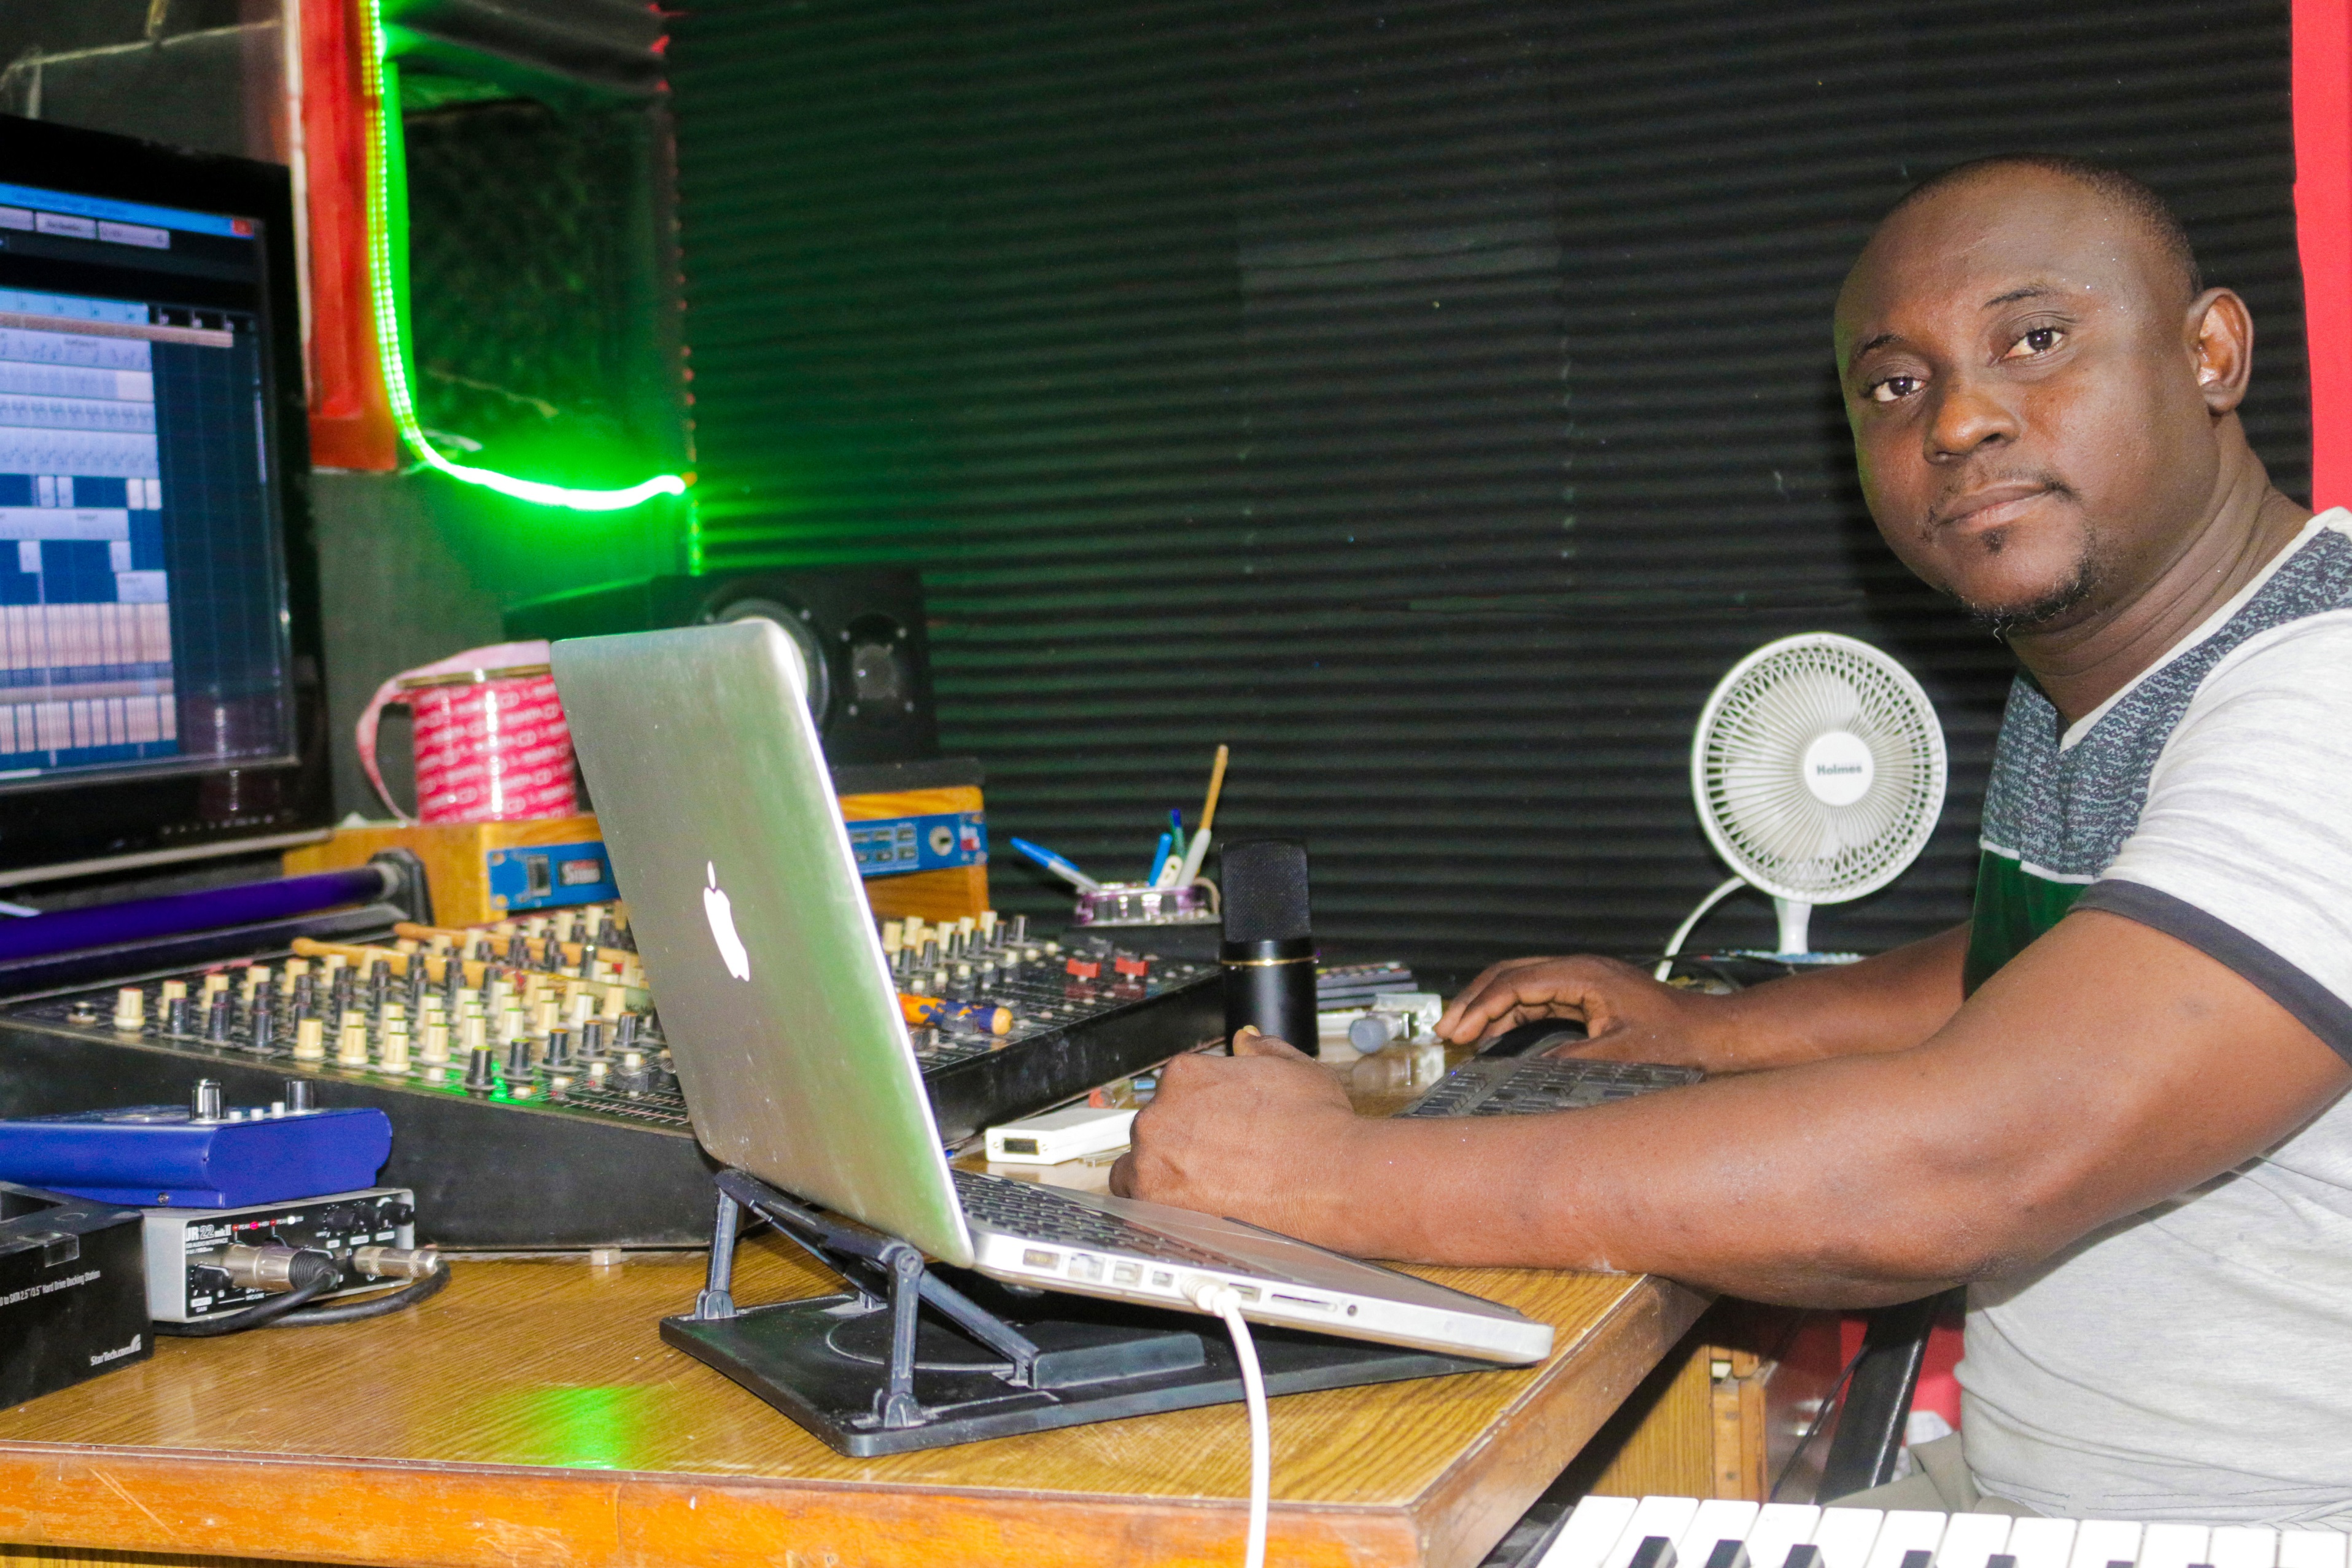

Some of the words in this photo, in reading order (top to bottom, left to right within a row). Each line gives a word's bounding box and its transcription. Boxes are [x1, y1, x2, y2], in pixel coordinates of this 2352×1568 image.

[1817, 764, 1863, 775] Holmes
[9, 1291, 20, 1303] SATA
[42, 1281, 54, 1294] Hard
[54, 1279, 66, 1290] Drive
[66, 1274, 85, 1287] Docking
[84, 1270, 101, 1281] Station
[90, 1346, 131, 1366] StarTech.com
